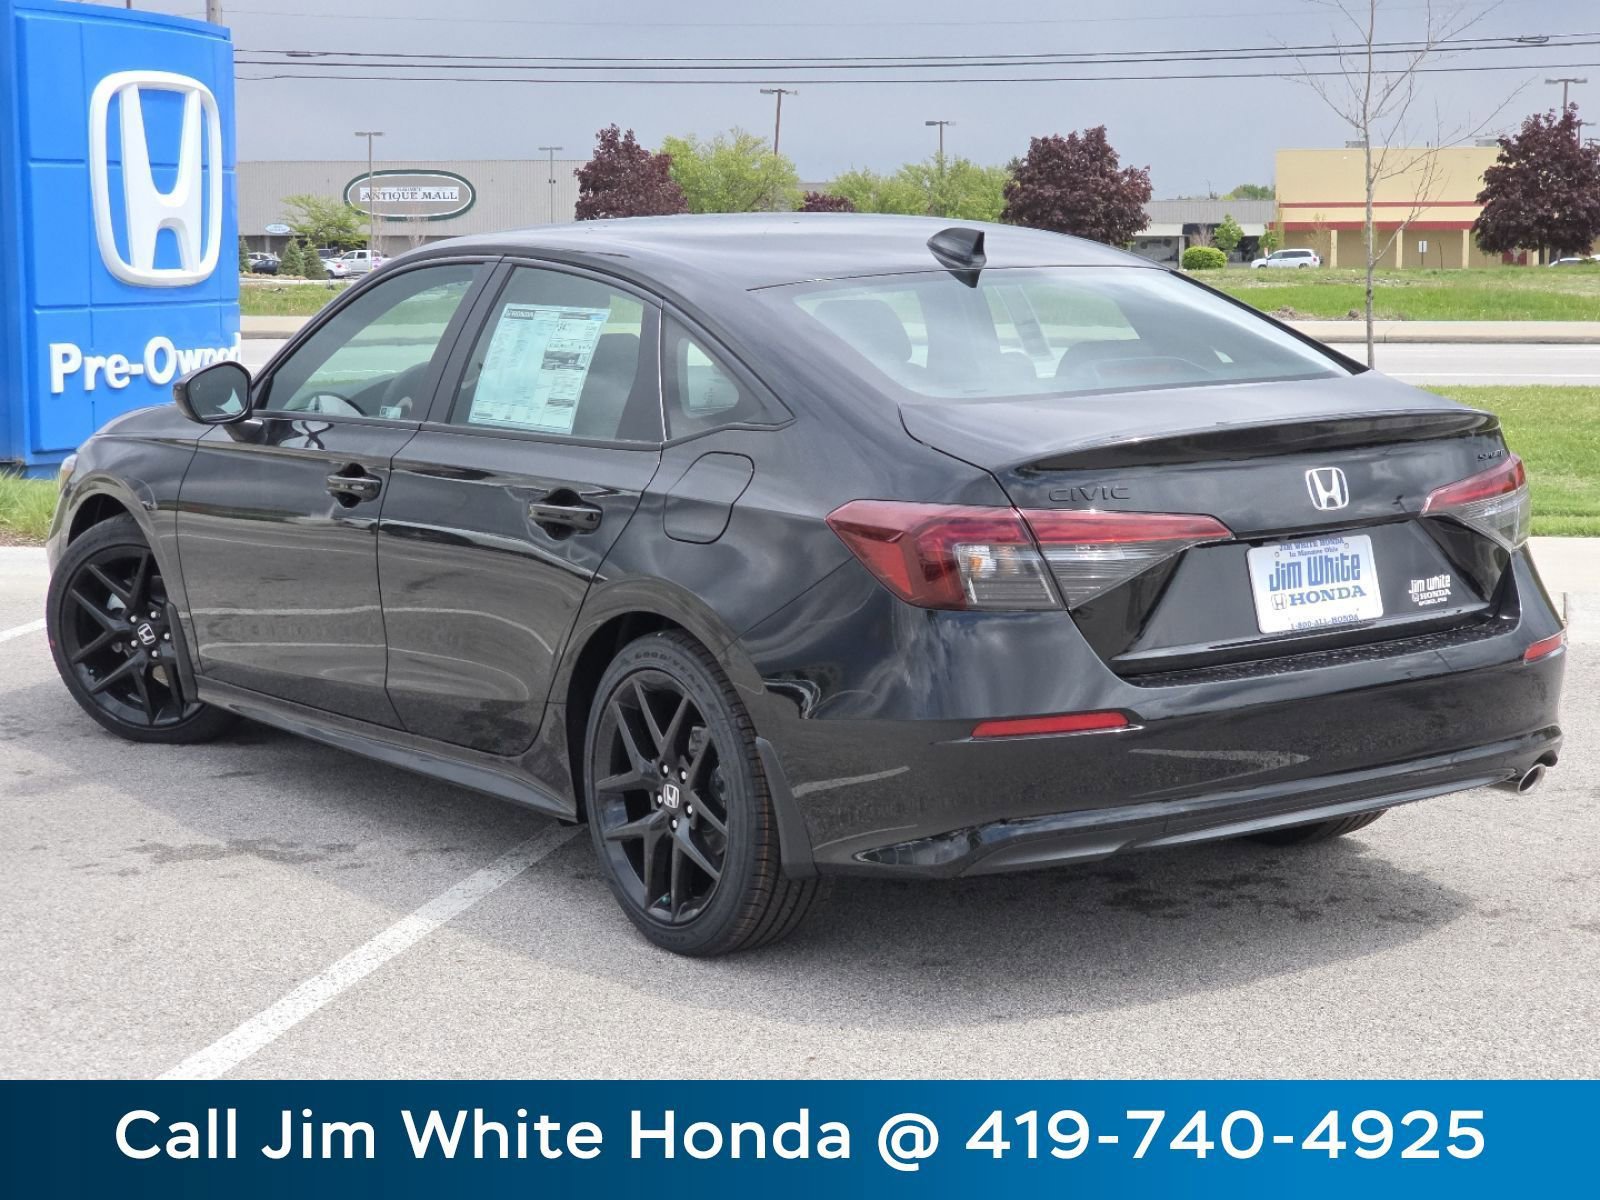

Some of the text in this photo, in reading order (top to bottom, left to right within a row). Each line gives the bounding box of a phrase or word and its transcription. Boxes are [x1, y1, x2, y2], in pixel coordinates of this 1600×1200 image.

[361, 191, 458, 201] ANTIQUE MALL
[1048, 486, 1131, 502] CIVIC
[1280, 537, 1345, 551] JIM WHITE HONDA
[1268, 553, 1361, 592] Jim White
[1408, 574, 1451, 594] Jim White
[1288, 585, 1367, 606] HONDA
